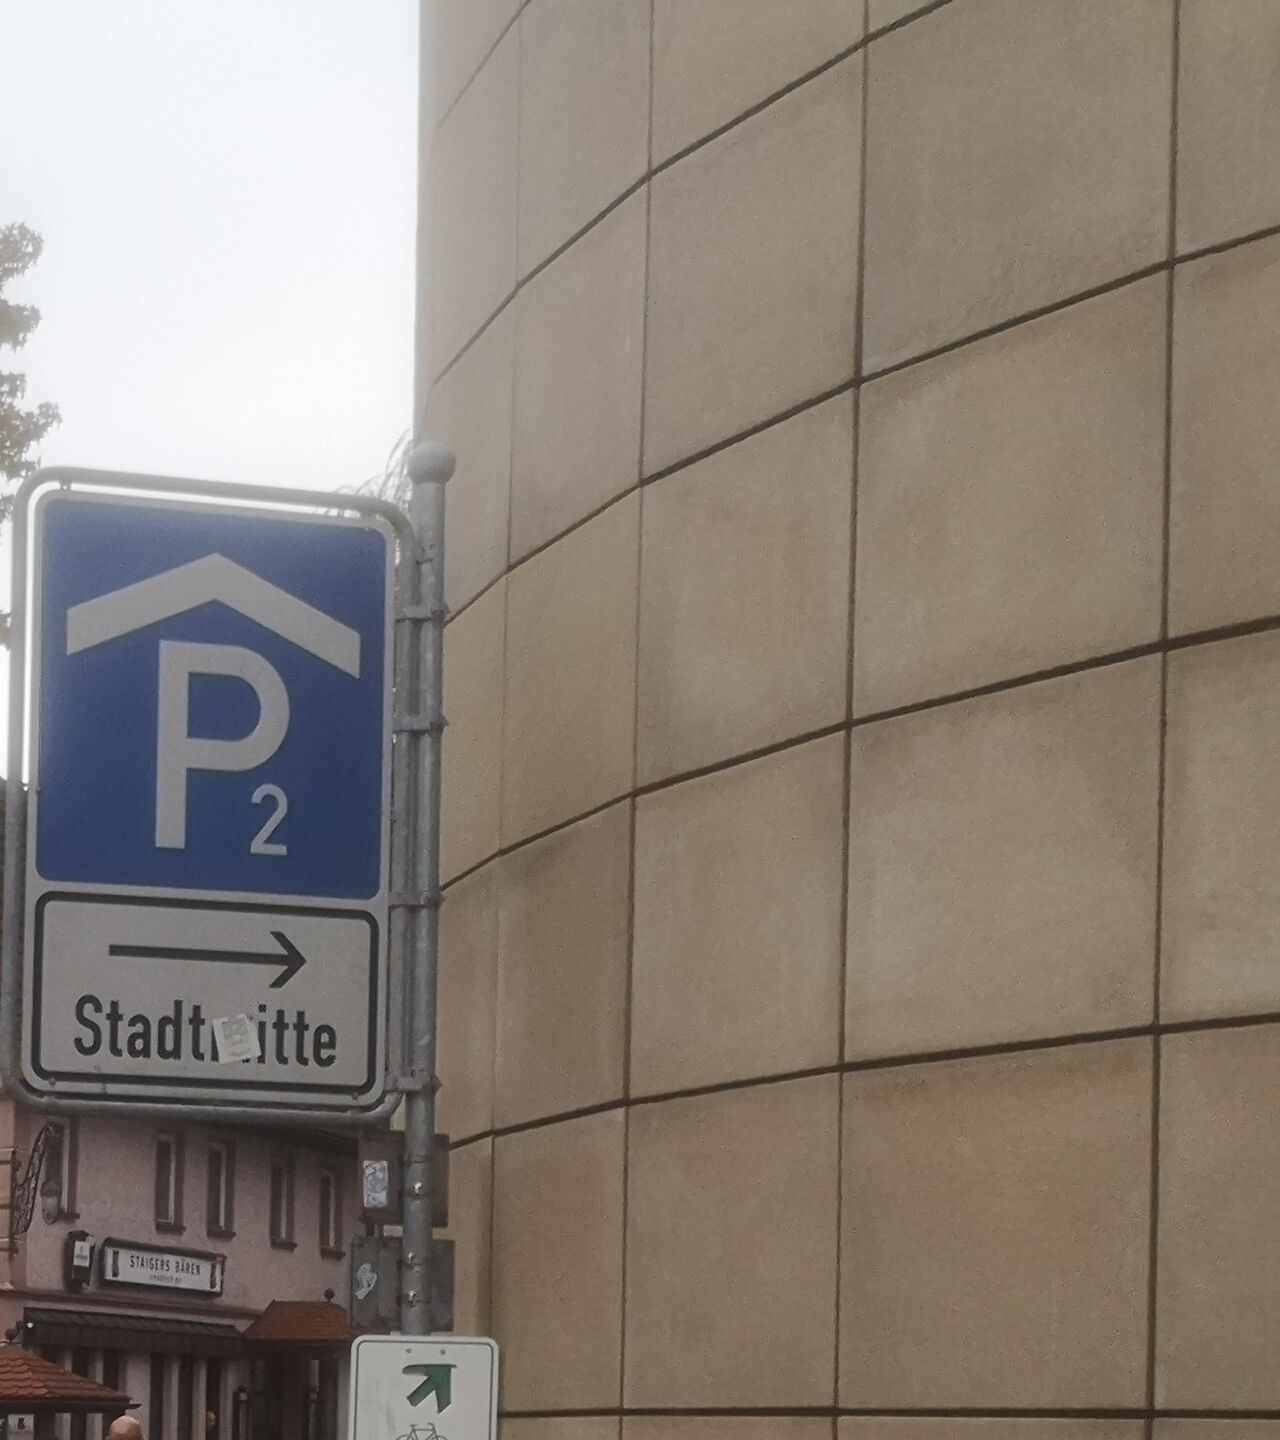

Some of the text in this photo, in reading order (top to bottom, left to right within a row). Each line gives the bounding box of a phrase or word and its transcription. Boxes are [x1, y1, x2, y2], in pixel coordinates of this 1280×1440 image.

[155, 639, 289, 849] P
[250, 783, 288, 856] 2
[74, 994, 336, 1068] Stadtitte
[130, 1255, 170, 1272] STAIGERS
